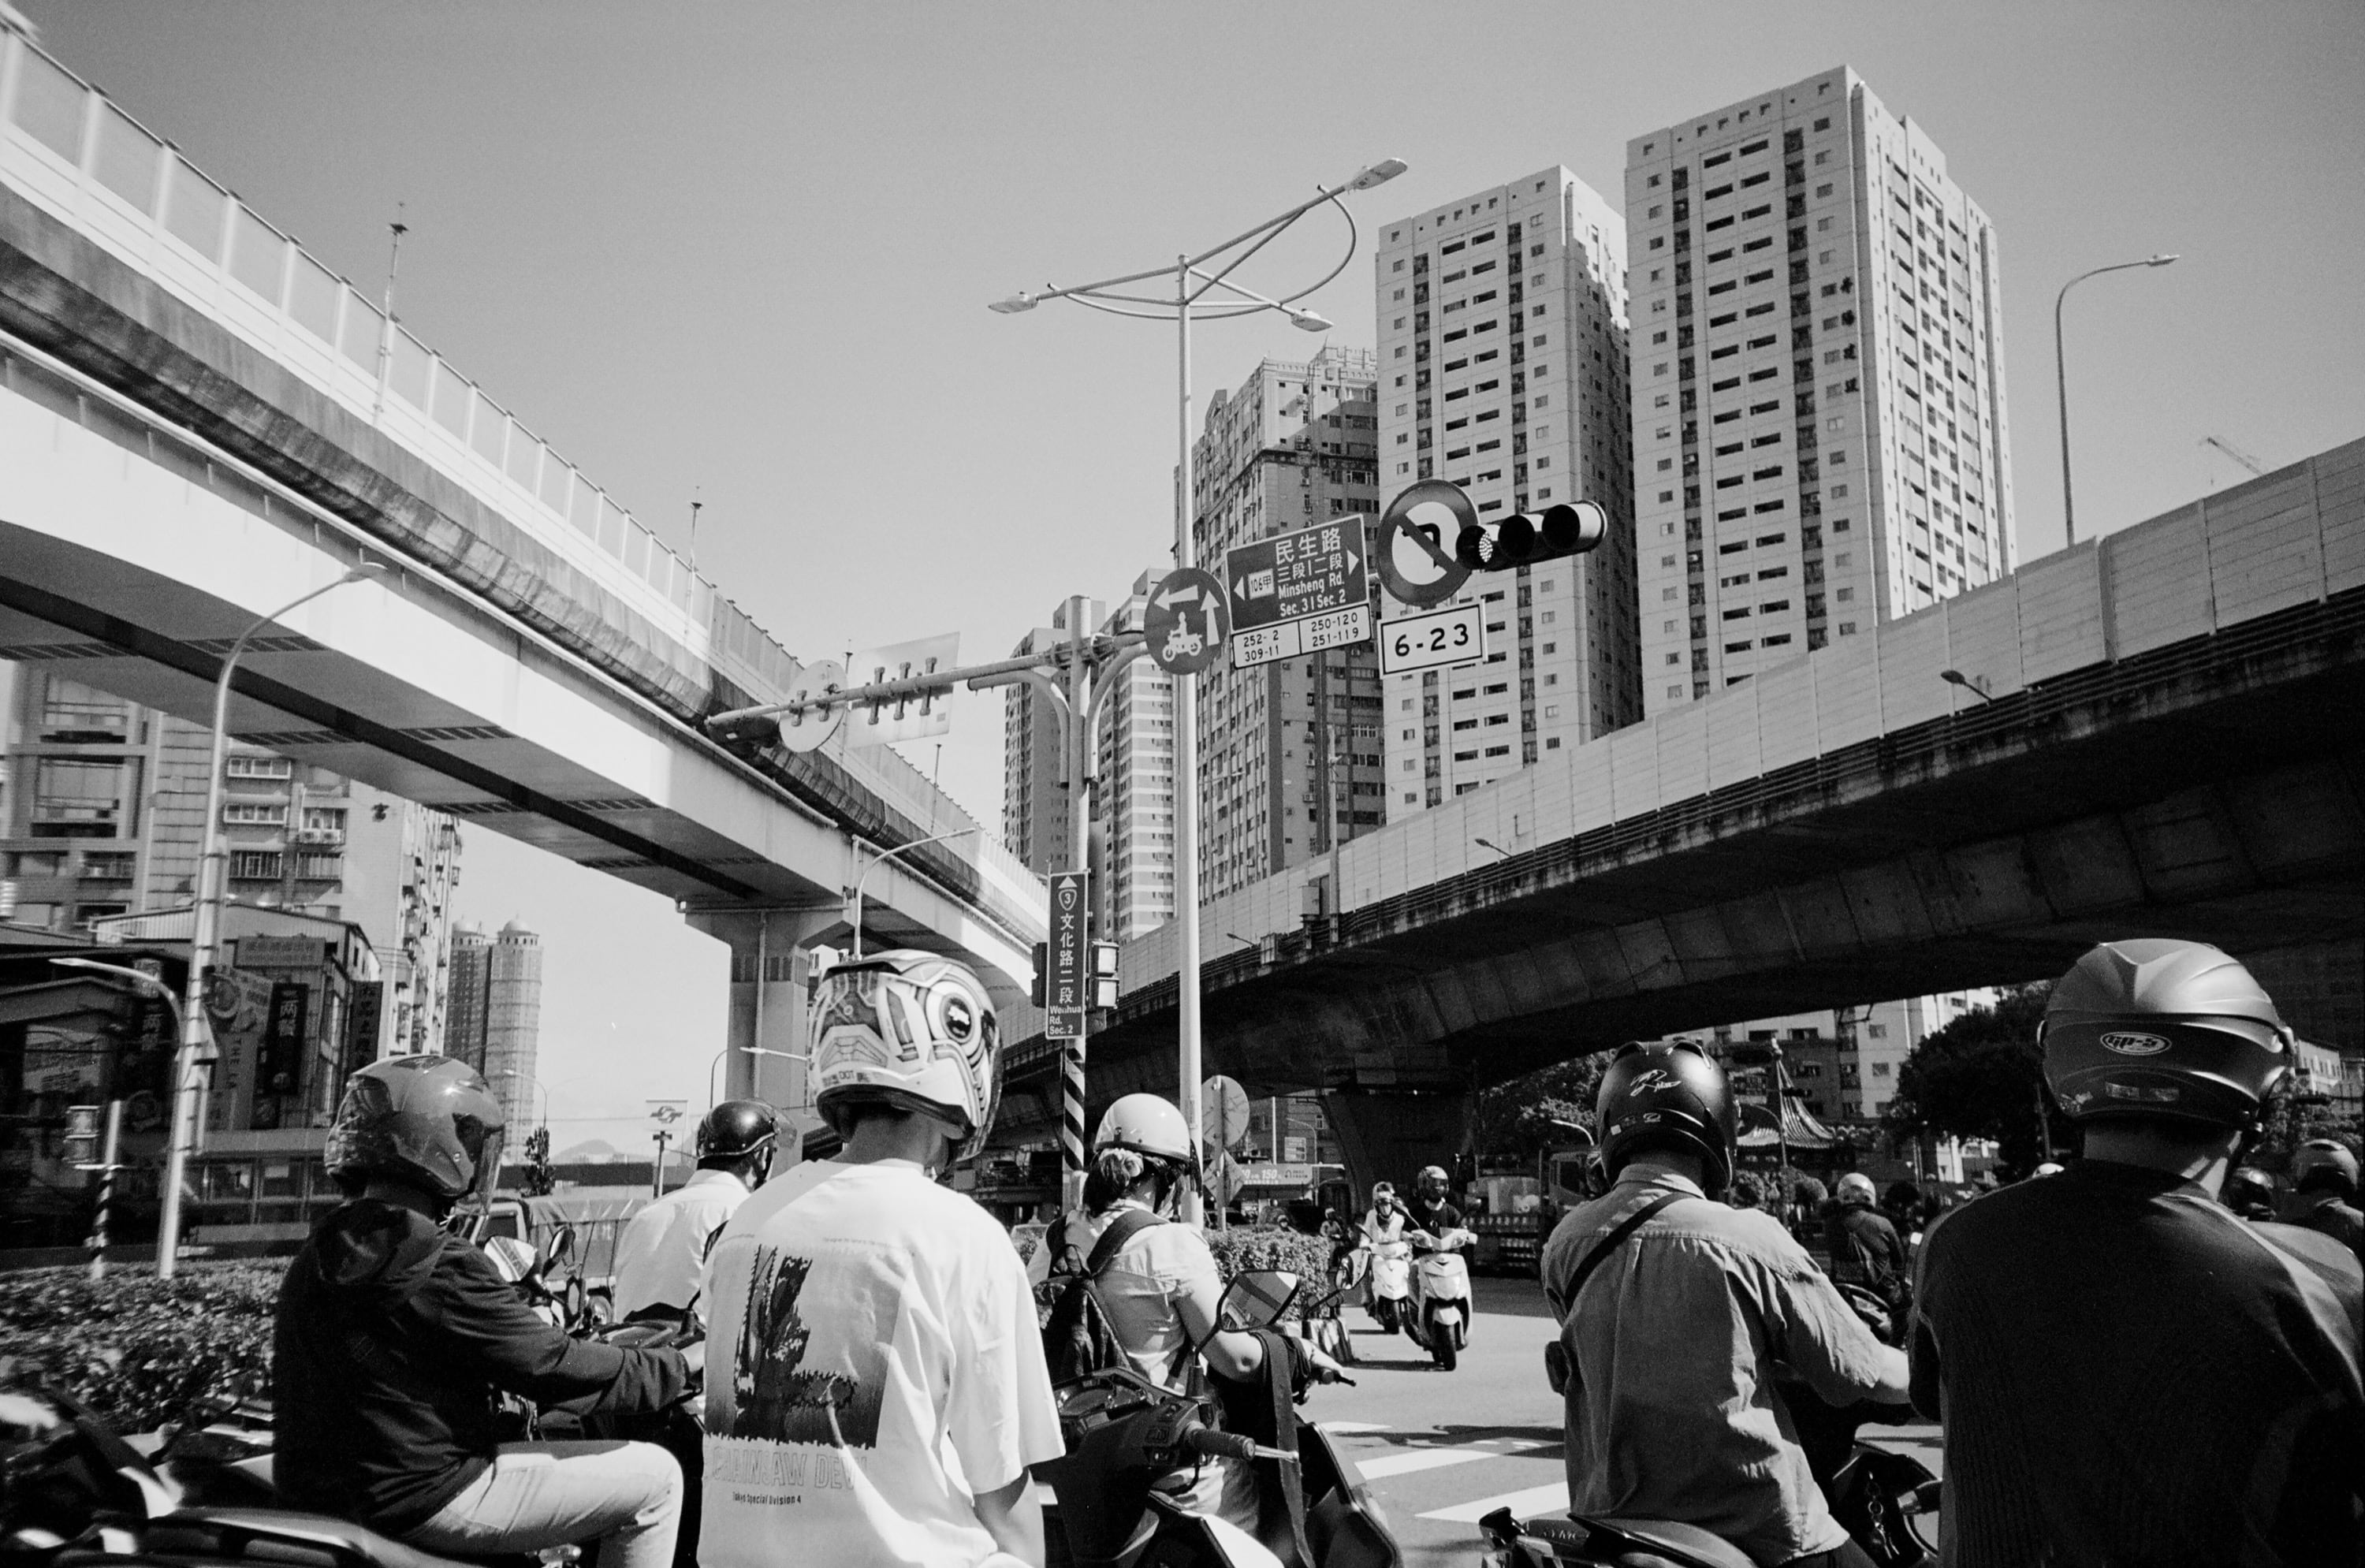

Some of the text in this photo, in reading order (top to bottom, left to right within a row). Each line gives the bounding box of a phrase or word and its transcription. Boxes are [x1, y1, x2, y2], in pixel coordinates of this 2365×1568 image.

[1276, 527, 1341, 565] 民生路
[1278, 571, 1345, 599] Minsheng Rd.
[1280, 602, 1299, 617] Sec.
[1302, 598, 1309, 613] 3
[1317, 594, 1337, 609] Sec.
[1339, 589, 1346, 604] 2
[1311, 612, 1358, 632] 250-120
[1313, 627, 1359, 647] 251-119
[1395, 623, 1469, 657] 6-23
[1245, 645, 1279, 662] 309-11
[1064, 892, 1071, 905] 3
[1059, 913, 1074, 1004] 文化路二段
[1049, 1005, 1082, 1015] Wenhua
[1049, 1015, 1063, 1025] Rd.
[1049, 1025, 1073, 1035] Sec. 2
